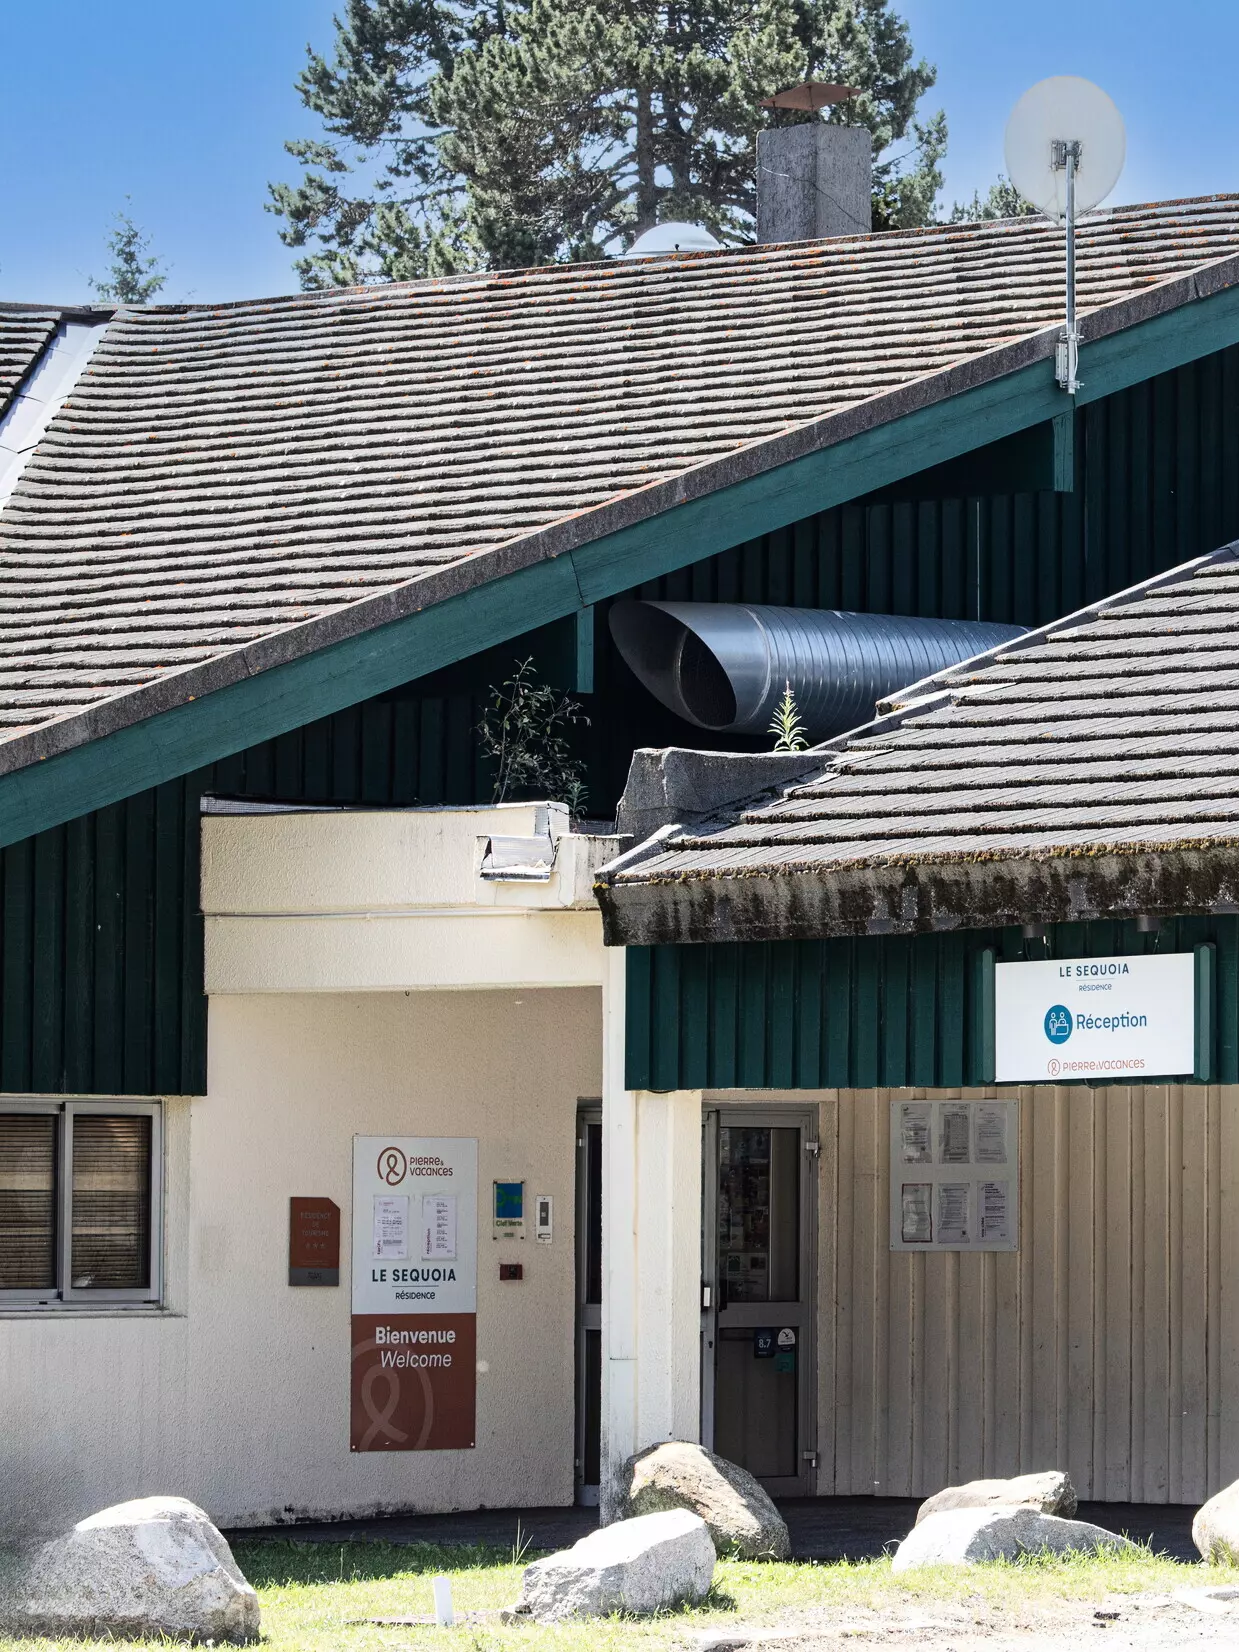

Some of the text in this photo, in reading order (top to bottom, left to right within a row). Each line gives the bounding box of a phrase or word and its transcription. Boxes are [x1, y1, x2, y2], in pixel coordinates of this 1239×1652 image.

[1059, 963, 1129, 978] LE SEQUOIA
[1076, 1011, 1147, 1032] Réception
[372, 1268, 457, 1282] LE SEQUOIA
[375, 1325, 456, 1344] Bienvenue
[758, 1338, 771, 1348] 8.7
[380, 1350, 452, 1368] Welcome
